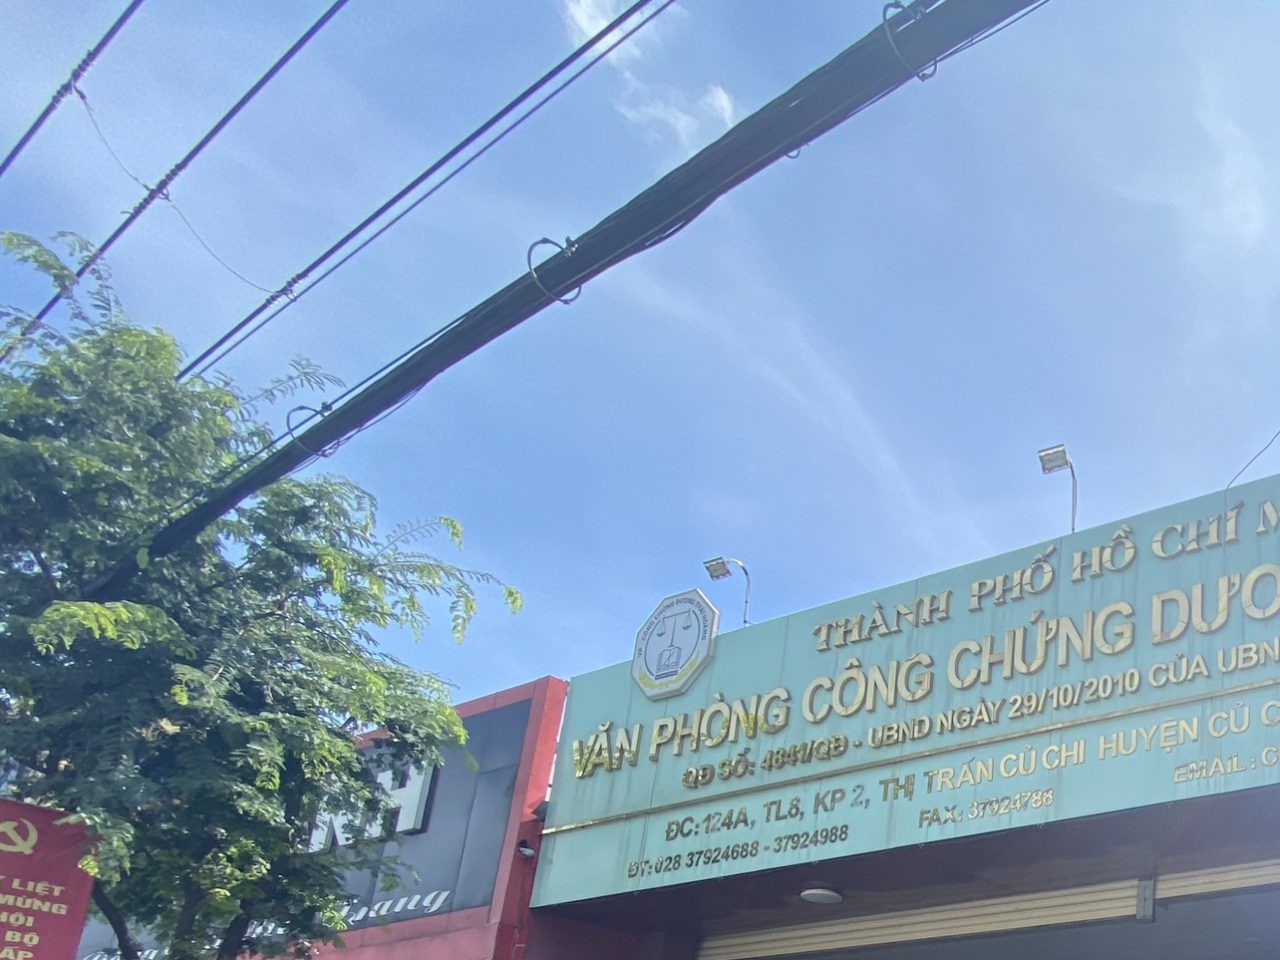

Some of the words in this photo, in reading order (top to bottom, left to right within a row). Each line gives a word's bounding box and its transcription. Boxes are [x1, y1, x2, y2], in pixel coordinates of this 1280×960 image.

[812, 590, 953, 652] THÀNH
[968, 545, 1057, 613] PHỐ
[1071, 523, 1137, 582] HỒ
[1151, 501, 1246, 561] CHÍ
[572, 720, 644, 779] VĂN
[650, 688, 791, 762] PHÒNG
[802, 656, 934, 724] CÔNG
[947, 603, 1136, 690] CHỨNG
[868, 715, 932, 749] UBND
[936, 697, 1004, 735] NGÀY
[1008, 667, 1141, 720] 29/10/2010
[1148, 649, 1210, 689] CỦA
[813, 788, 846, 815] KP
[879, 773, 915, 802] THỊ
[1000, 744, 1037, 778] CỦ
[1042, 739, 1086, 770] CHI
[1208, 701, 1250, 738] CỦ
[918, 804, 963, 828] FAX:
[968, 787, 1055, 819] 37924788
[686, 840, 760, 869] 37924688
[773, 824, 849, 854] 37924988
